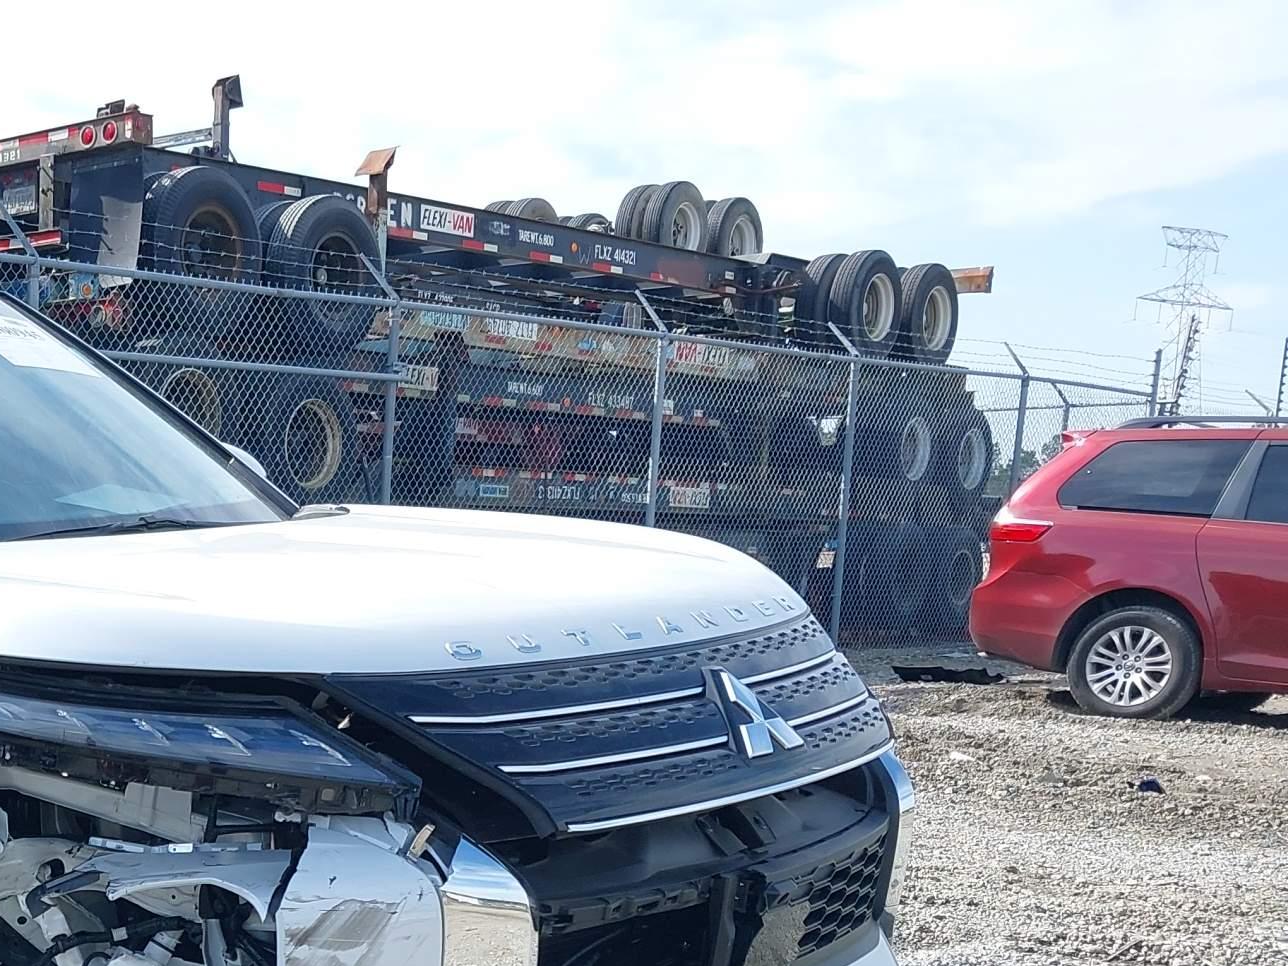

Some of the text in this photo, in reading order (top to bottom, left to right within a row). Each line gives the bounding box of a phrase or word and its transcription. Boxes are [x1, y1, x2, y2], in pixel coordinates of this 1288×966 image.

[421, 208, 473, 234] FLEXI-VAN
[594, 244, 636, 265] FLXZ 414321
[444, 595, 797, 662] OUTLANDER
